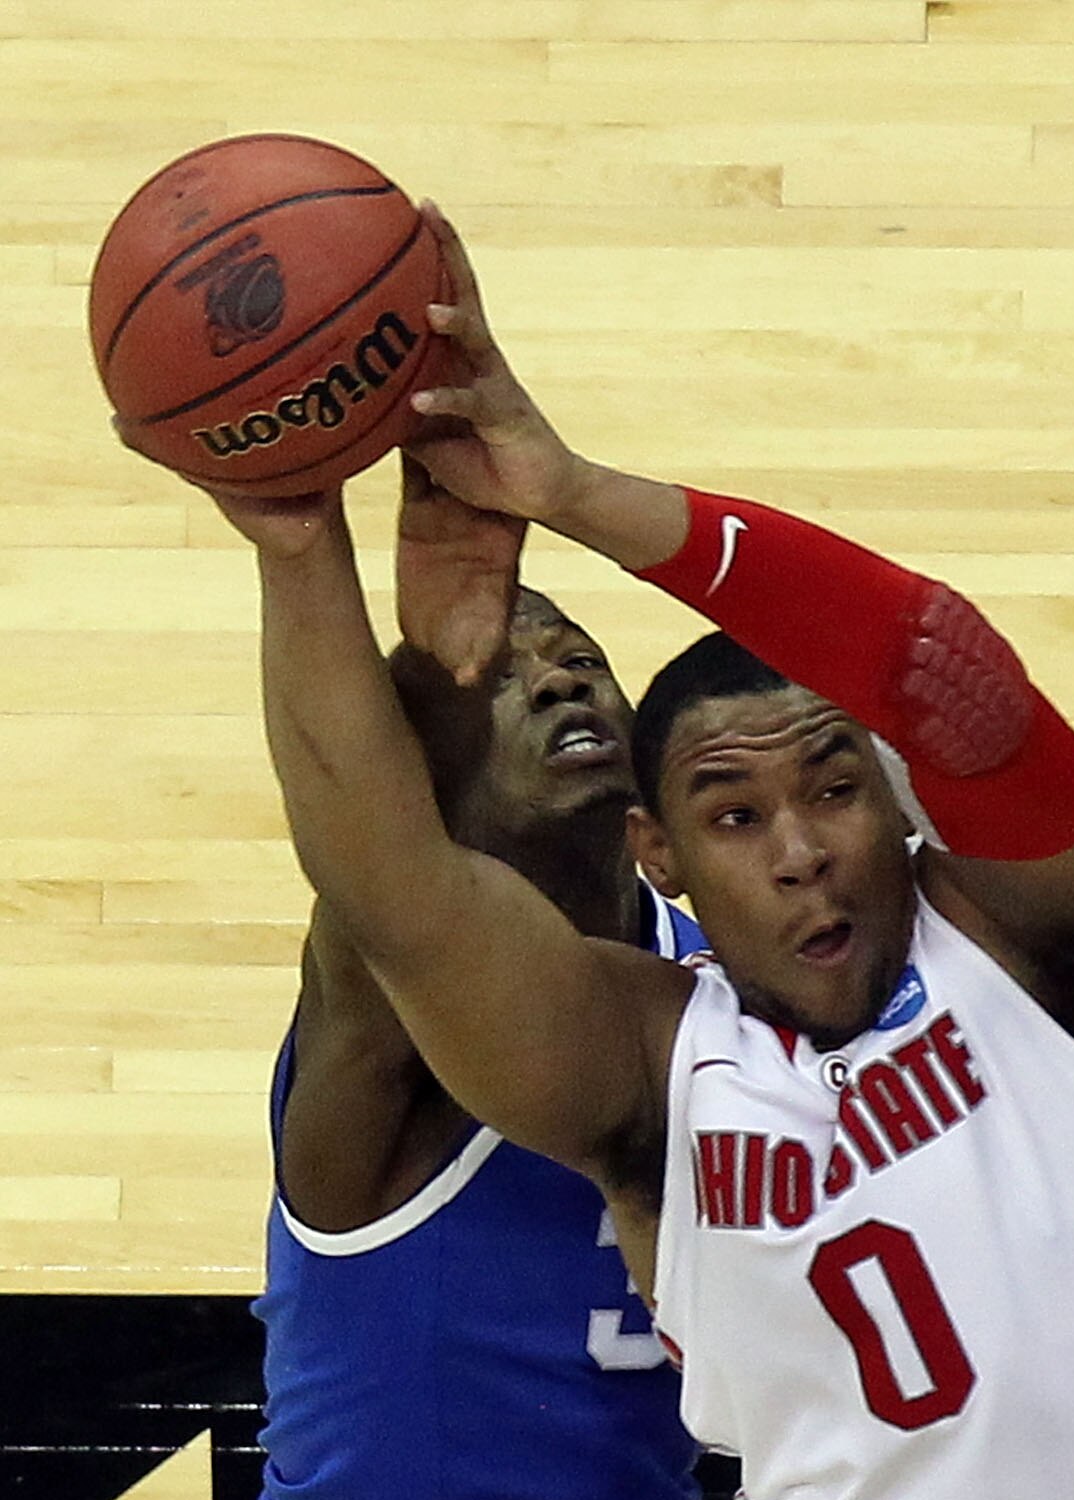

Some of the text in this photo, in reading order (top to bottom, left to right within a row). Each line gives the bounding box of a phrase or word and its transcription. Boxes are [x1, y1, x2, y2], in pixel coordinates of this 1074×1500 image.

[191, 312, 418, 459] Wilson
[693, 1129, 816, 1230] HIO
[808, 1219, 979, 1432] 0
